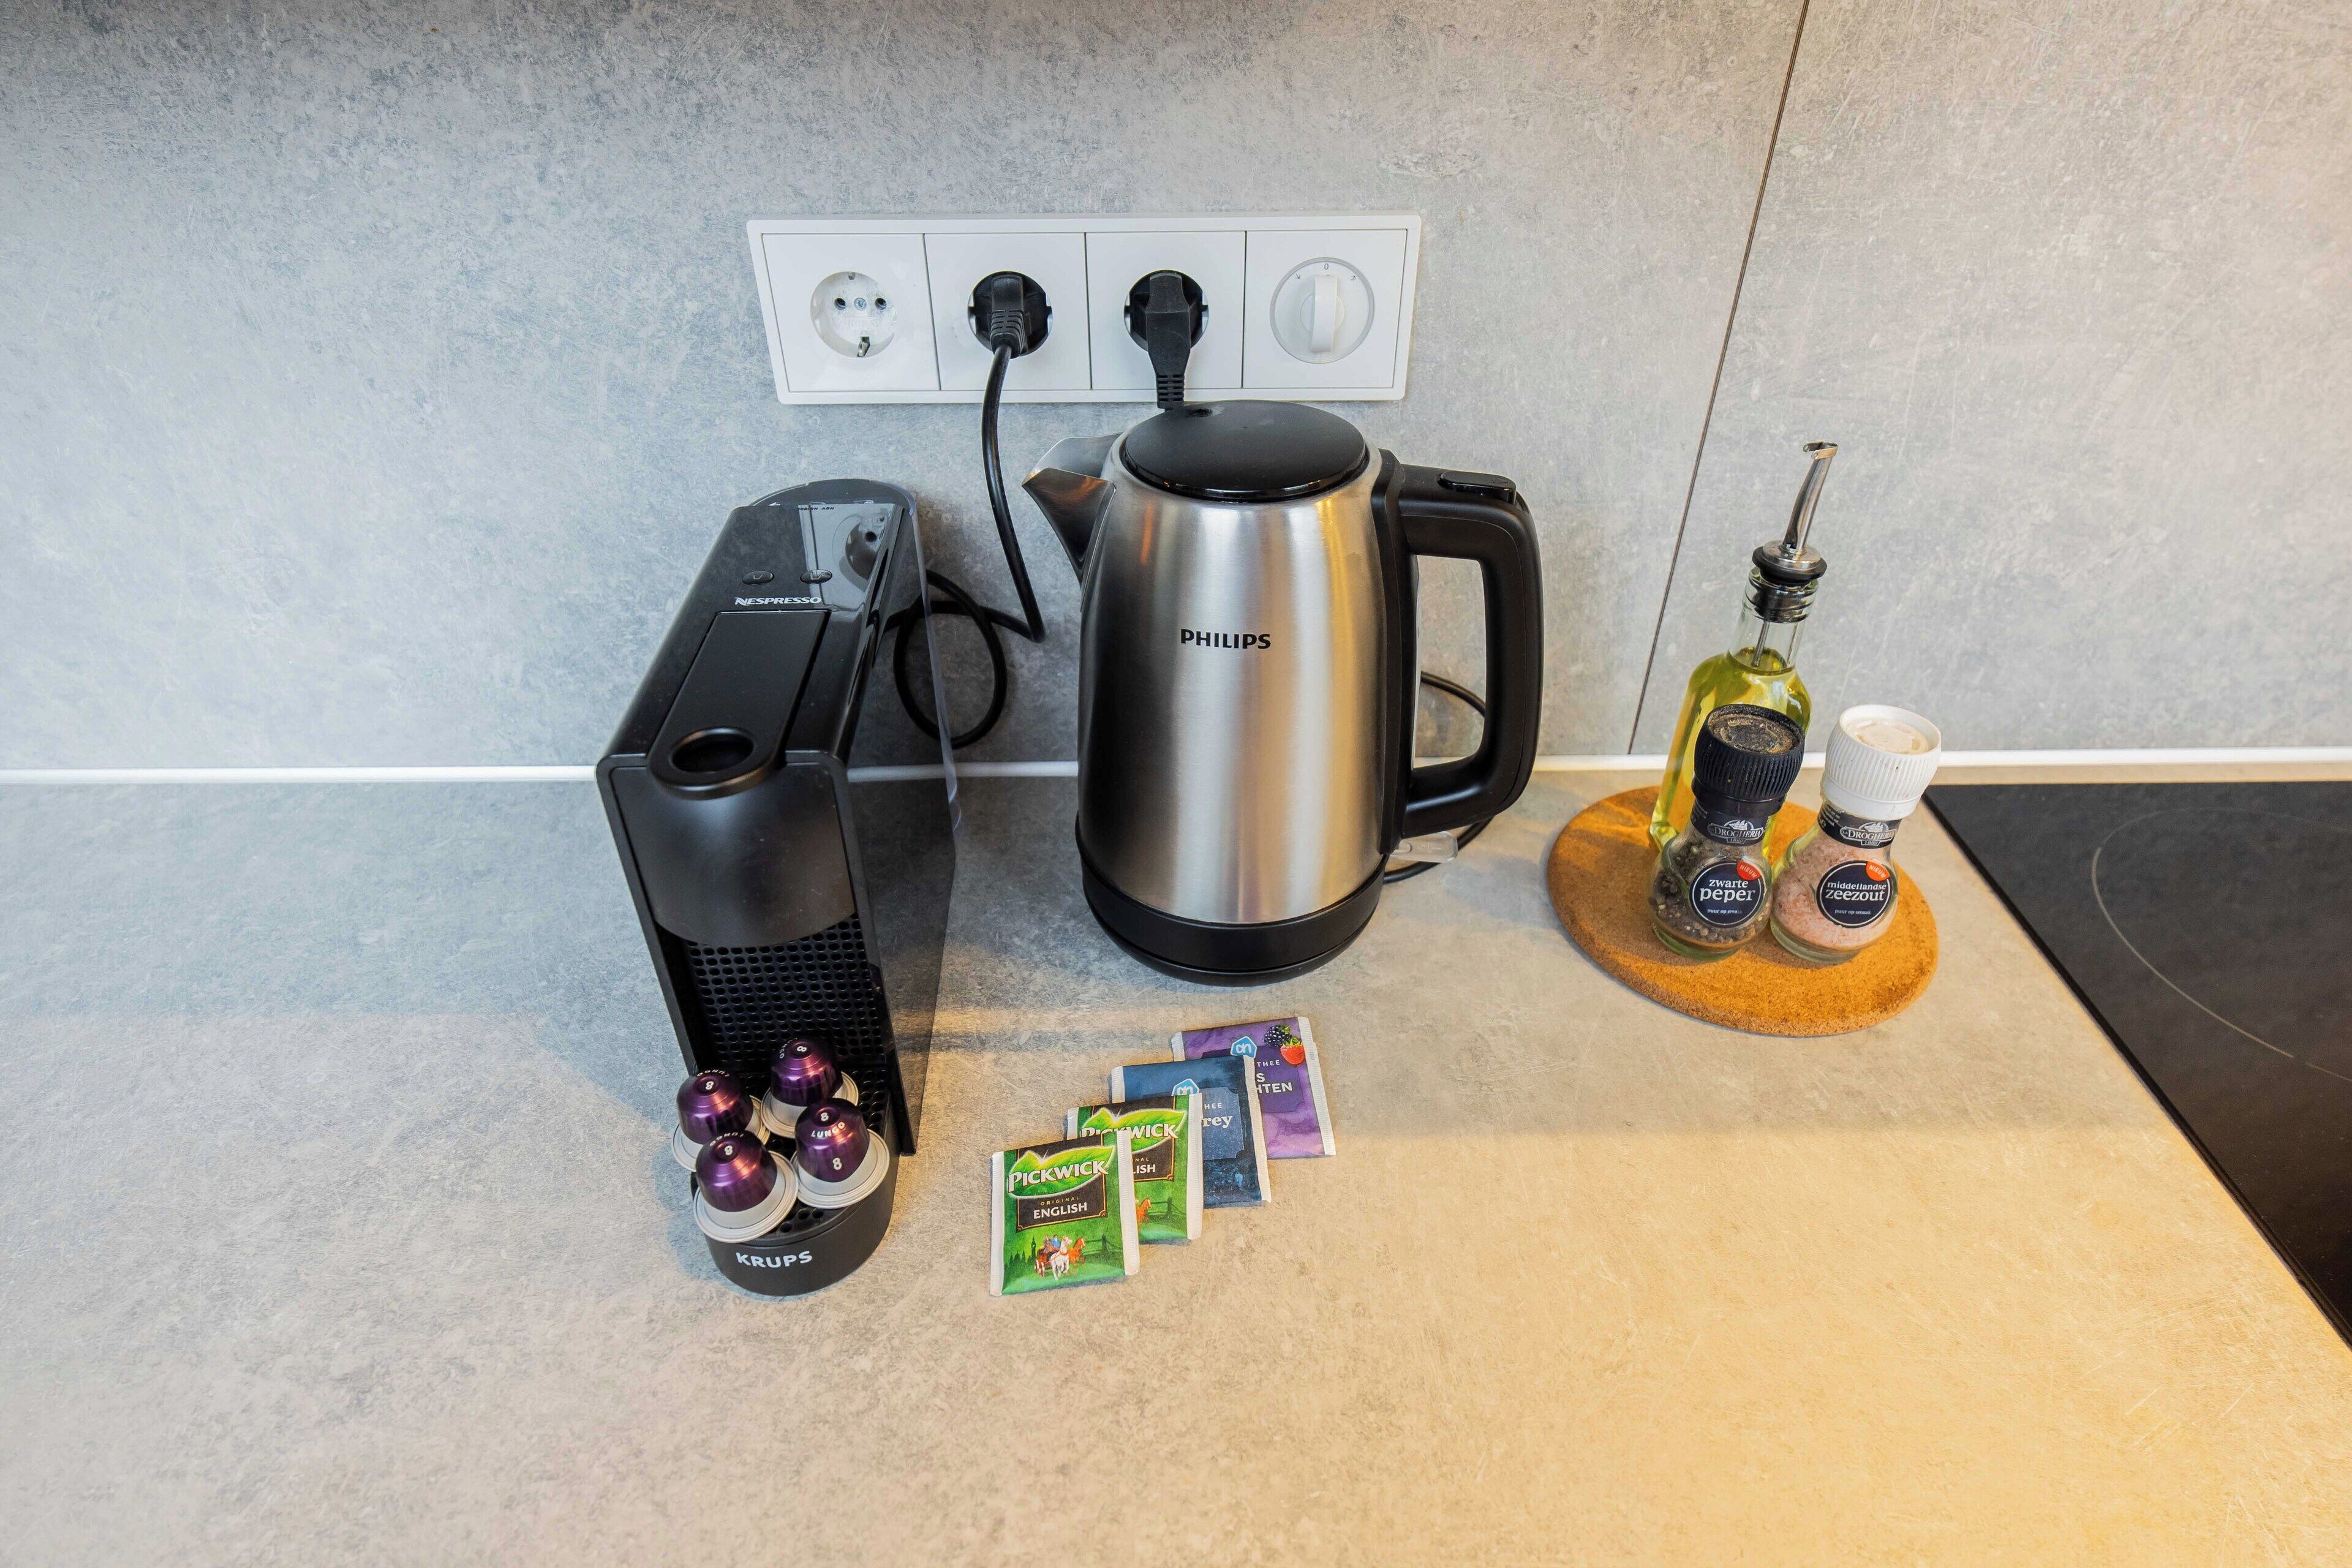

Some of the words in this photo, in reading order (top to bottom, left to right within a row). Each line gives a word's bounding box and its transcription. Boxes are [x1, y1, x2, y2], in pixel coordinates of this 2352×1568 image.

[734, 597, 822, 606] NESPRESSO
[1181, 628, 1272, 649] PHILIPS
[1740, 864, 1757, 878] NIEUW
[1869, 864, 1887, 878] NIEUW
[1709, 879, 1749, 888] zwarte
[1827, 881, 1887, 891] middellandse
[1700, 888, 1755, 903] peper
[1825, 889, 1885, 901] zeezout
[704, 1080, 715, 1090] 8
[820, 1112, 829, 1121] 8
[1202, 1115, 1233, 1129] rey
[810, 1121, 845, 1138] LUNGO
[724, 1145, 734, 1156] 8
[832, 1157, 842, 1170] 8
[1008, 1161, 1109, 1193] PICKWICK
[1040, 1196, 1080, 1206] ORIGINAL
[1033, 1202, 1088, 1219] ENGLISH
[736, 1250, 813, 1268] KRUPS
